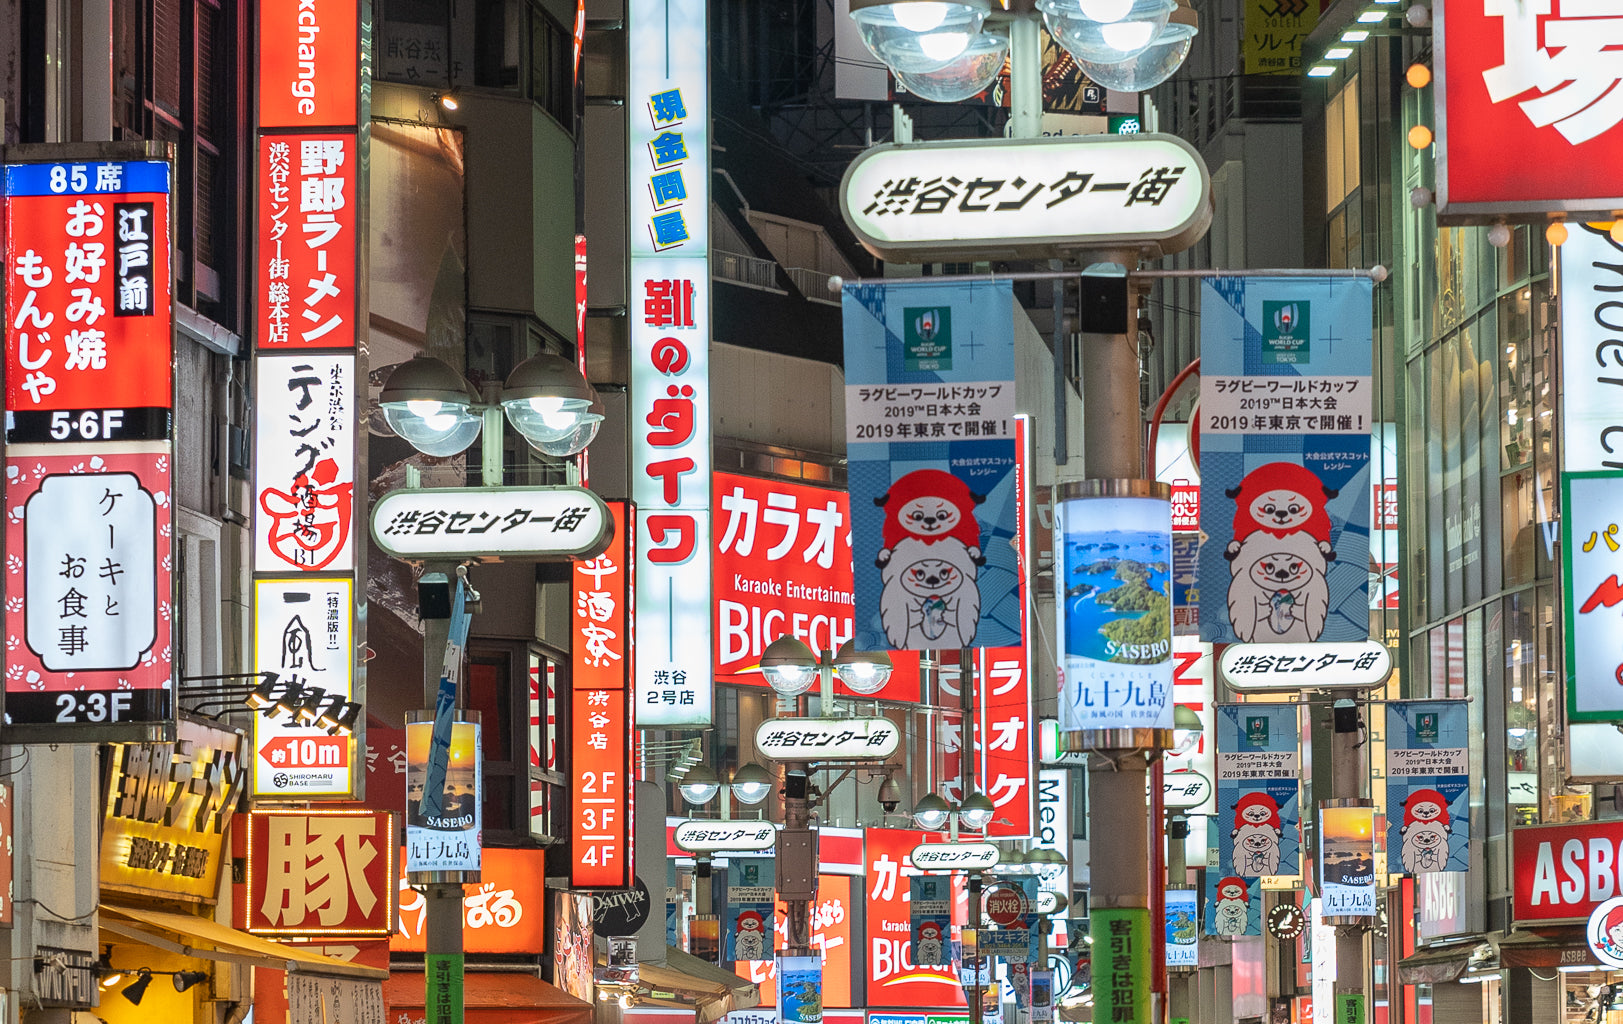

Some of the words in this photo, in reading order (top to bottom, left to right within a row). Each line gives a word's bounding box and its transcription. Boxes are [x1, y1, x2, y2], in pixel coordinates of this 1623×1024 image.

[650, 87, 690, 248] 現金問屋
[862, 166, 1187, 217] 渋谷センター街
[299, 139, 345, 343] 野郎ラーメン
[118, 208, 149, 311] 江戸前
[65, 199, 107, 371] お好み焼
[14, 249, 57, 404] もんじゃ
[859, 385, 1002, 402] ラグビーワールドカップ
[1214, 380, 1359, 394] ラグビーワールドカップ
[287, 364, 335, 480] テング
[644, 279, 698, 567] 靴のダイワ
[1305, 452, 1369, 461] 大会公式マスコット
[1323, 462, 1352, 471] レンジー
[969, 469, 998, 477] レンジー
[292, 484, 319, 543] 酒場
[384, 507, 592, 536] 渋谷センター街
[1170, 516, 1199, 526] 創優品
[718, 486, 853, 569] カラオ
[98, 488, 125, 616] ケーキと
[734, 574, 782, 596] Karaoke
[57, 553, 89, 656] お食事
[1104, 638, 1169, 660] SASEBO
[1228, 651, 1382, 674] 渋谷センター街
[653, 670, 687, 686] 渋谷
[646, 690, 695, 706] 2号店
[1073, 680, 1166, 709] 九十九島
[587, 691, 611, 750] 渋谷店
[762, 730, 891, 748] 渋谷センター街
[1224, 753, 1292, 761] ラグビーワールドカップ
[1392, 750, 1462, 758] ラグビーワールドカップ
[582, 771, 616, 793] 2F
[426, 813, 473, 828] SASEBO
[582, 807, 616, 831] 3F
[681, 828, 772, 842] 渋谷センター街
[582, 845, 616, 867] 4F
[916, 850, 994, 863] 渋谷センター街
[261, 815, 378, 927] 豚
[1531, 837, 1623, 906] ASB
[989, 900, 1020, 914] 消火栓
[992, 931, 1029, 944] セキネ
[1560, 949, 1587, 963] ASBee
[1109, 918, 1136, 1024] 客引きは犯罪
